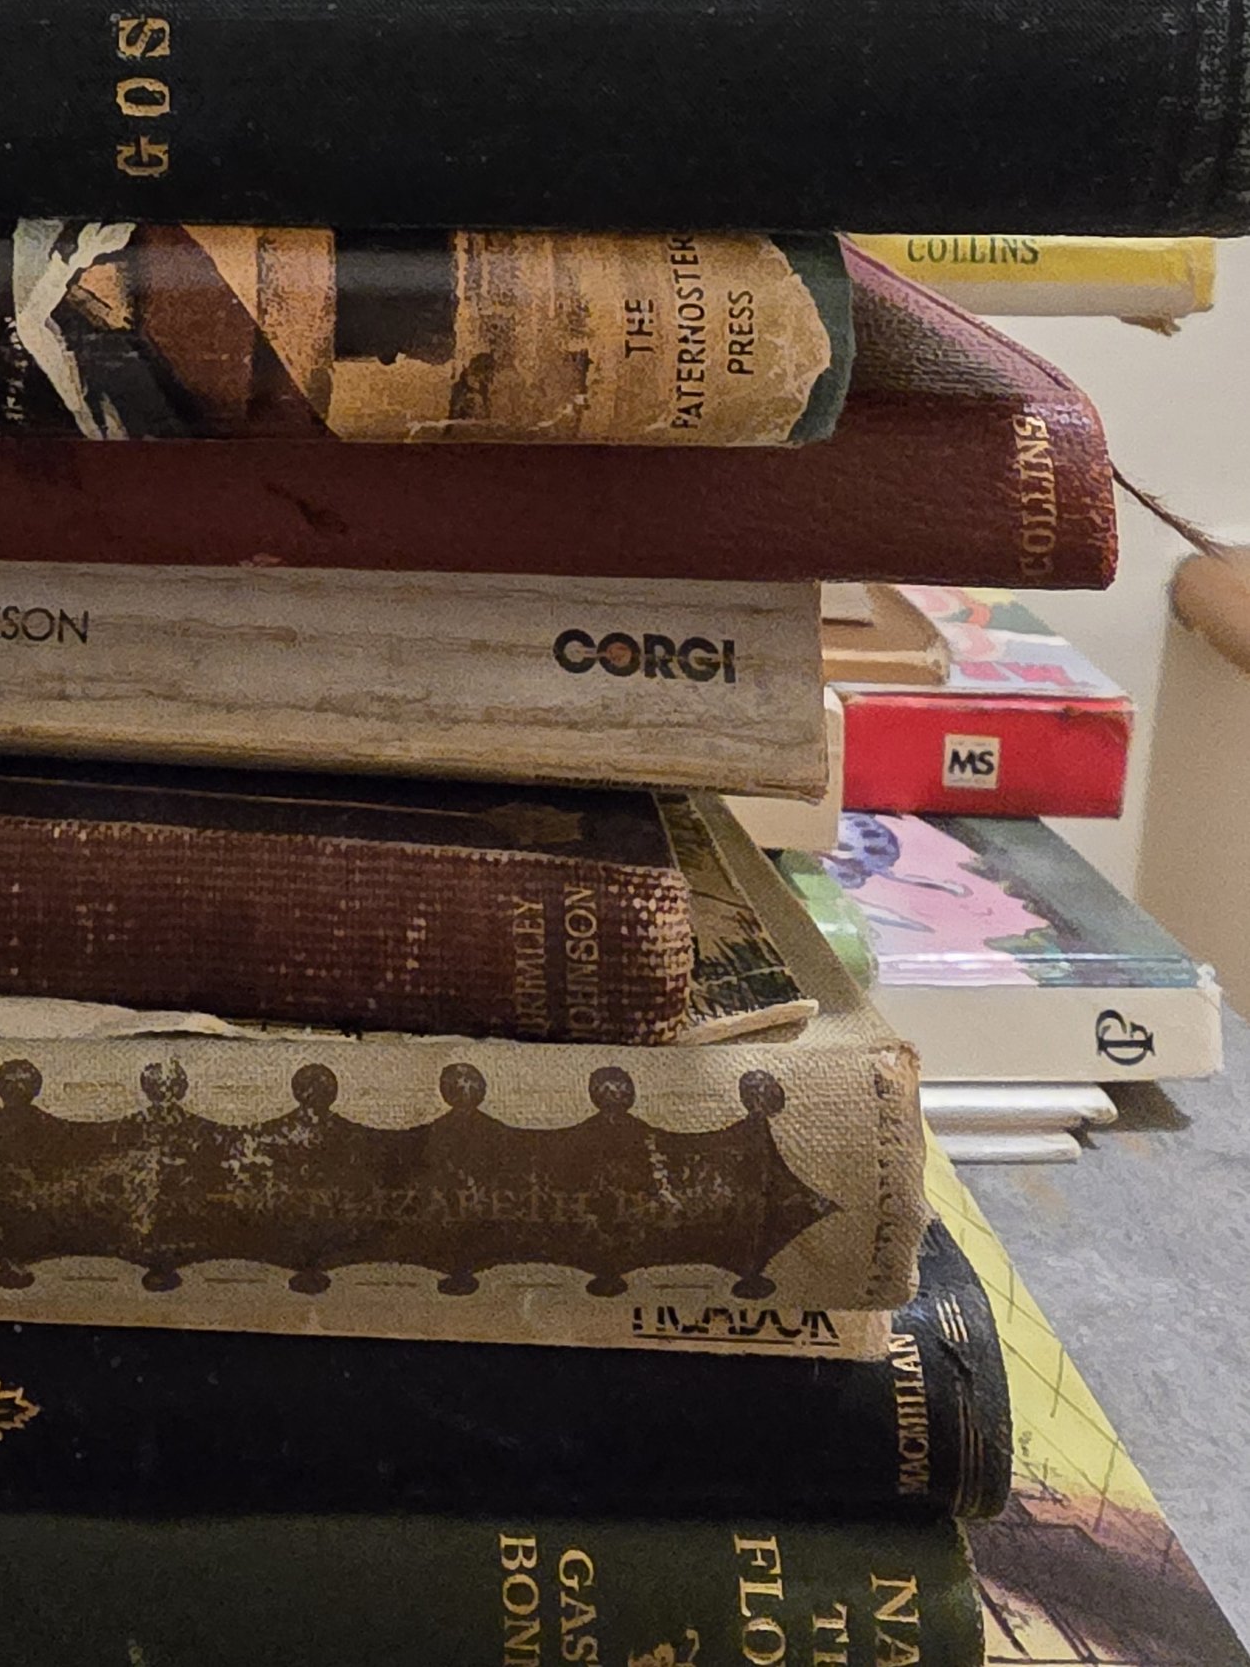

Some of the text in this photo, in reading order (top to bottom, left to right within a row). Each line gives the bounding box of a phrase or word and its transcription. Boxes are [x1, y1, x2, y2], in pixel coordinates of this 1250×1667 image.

[906, 236, 1040, 266] COLLINS
[623, 297, 655, 359] THE
[668, 231, 708, 430] PATERNOSTER
[727, 288, 756, 376] PRESS
[1011, 413, 1058, 582] COLLINS
[553, 628, 736, 684] CORGI
[947, 747, 995, 777] MS
[889, 1334, 931, 1496] MACMILLAN
[498, 1532, 542, 1667] BON
[557, 1548, 598, 1667] GAS
[732, 1534, 787, 1667] FLO
